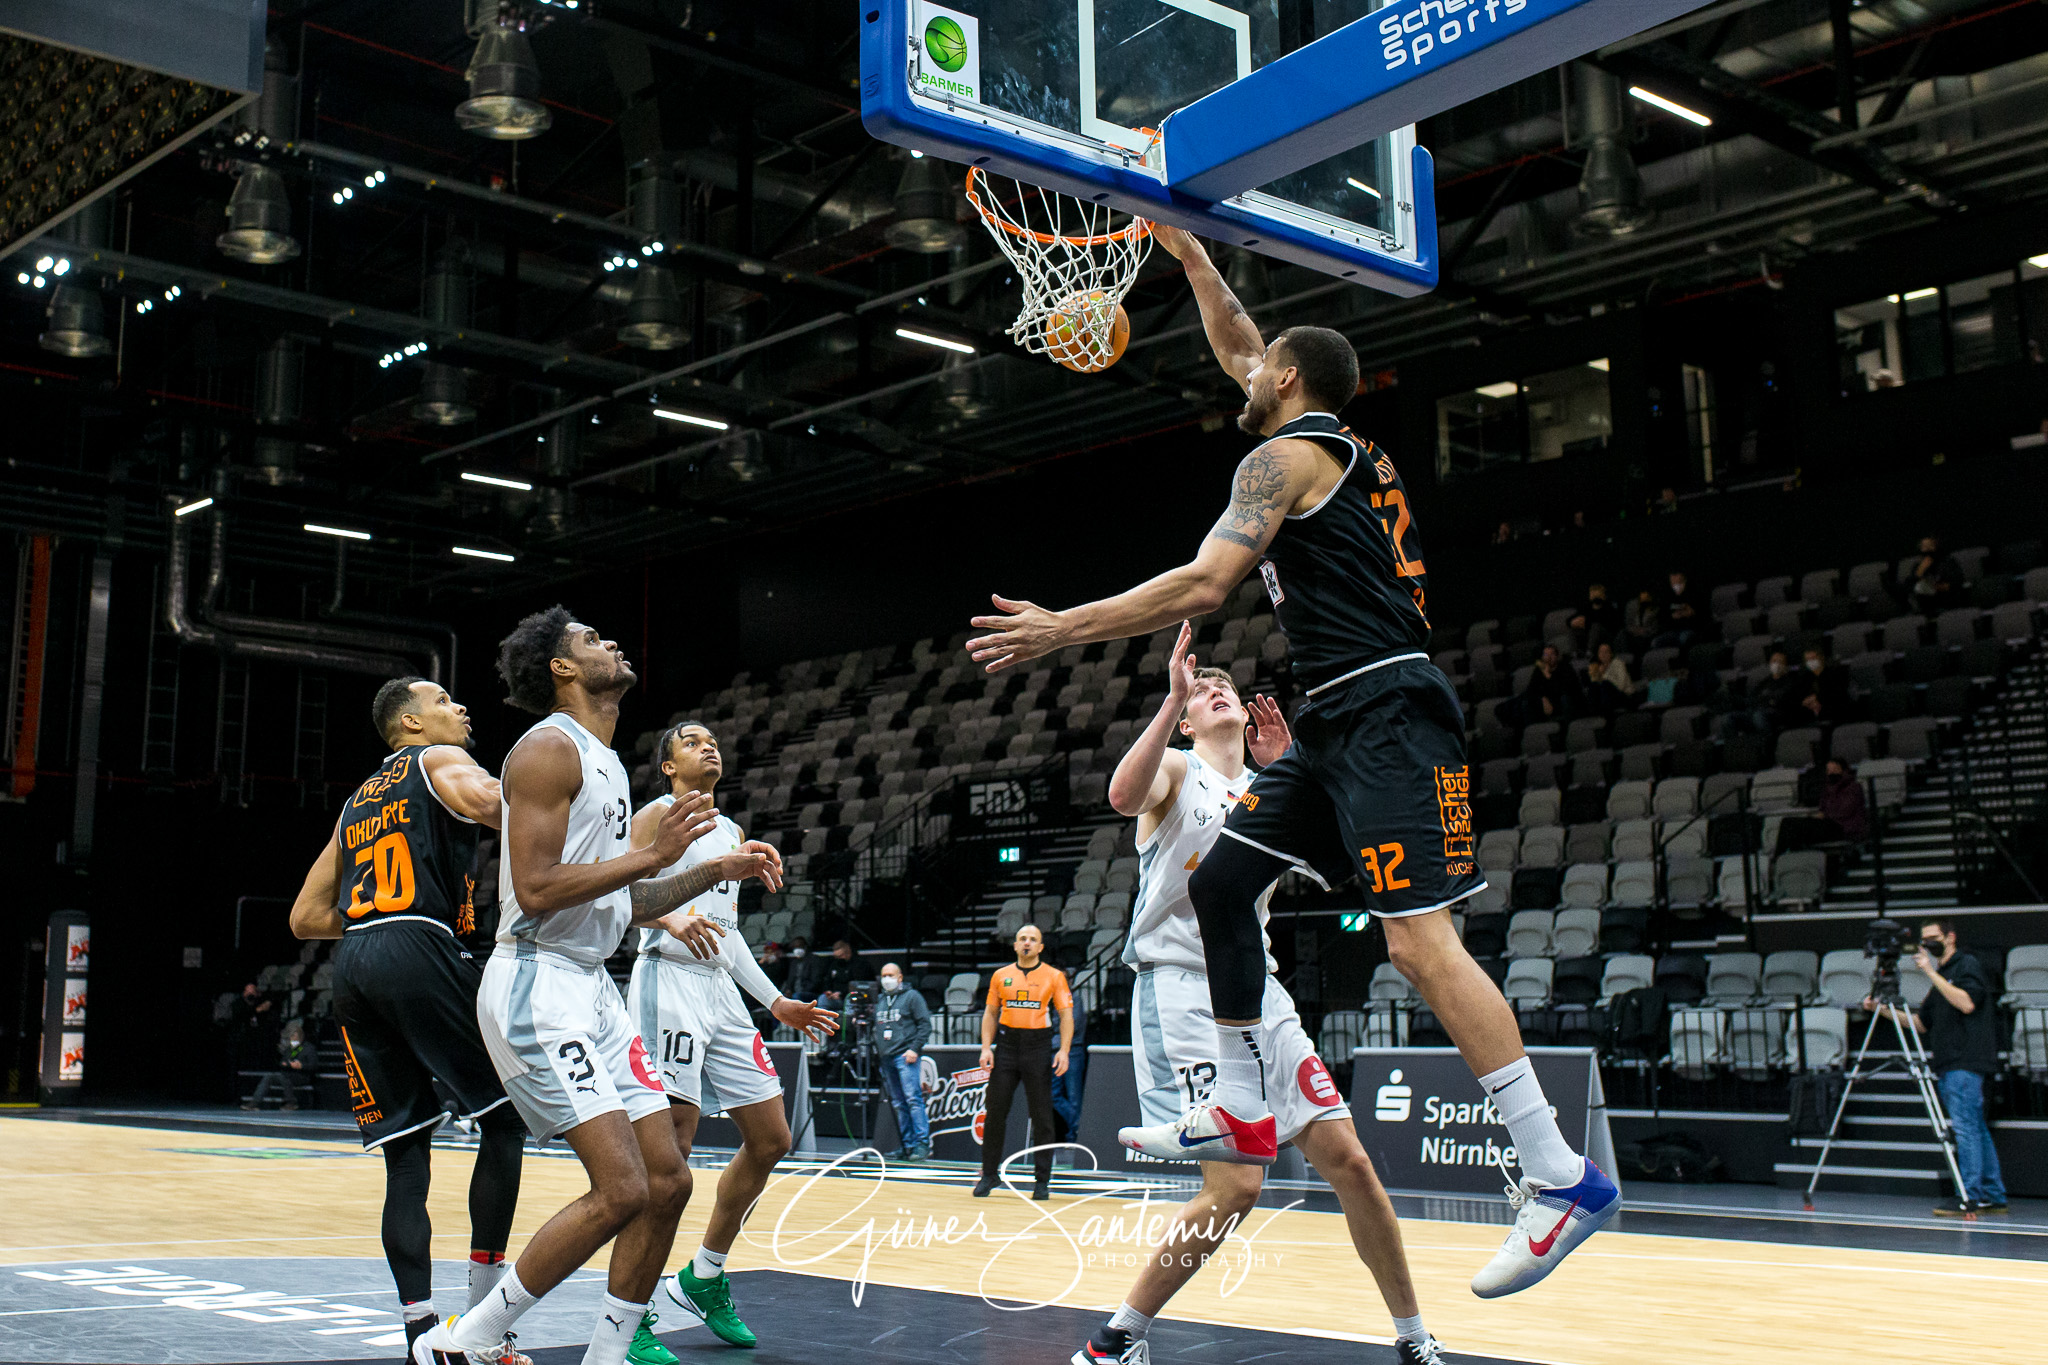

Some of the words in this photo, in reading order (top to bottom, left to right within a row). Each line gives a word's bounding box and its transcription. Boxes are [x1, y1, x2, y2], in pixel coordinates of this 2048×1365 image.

[1379, 0, 1476, 46] Sche
[1383, 0, 1527, 71] Sports
[920, 72, 975, 99] BARMER
[615, 797, 627, 840] 3
[346, 831, 416, 919] 20
[1360, 841, 1411, 893] 32
[558, 1040, 595, 1082] 3
[662, 1028, 694, 1066] 10
[925, 1077, 987, 1122] alcon
[1178, 1061, 1217, 1103] 13
[1420, 1136, 1521, 1168] Nürnbe
